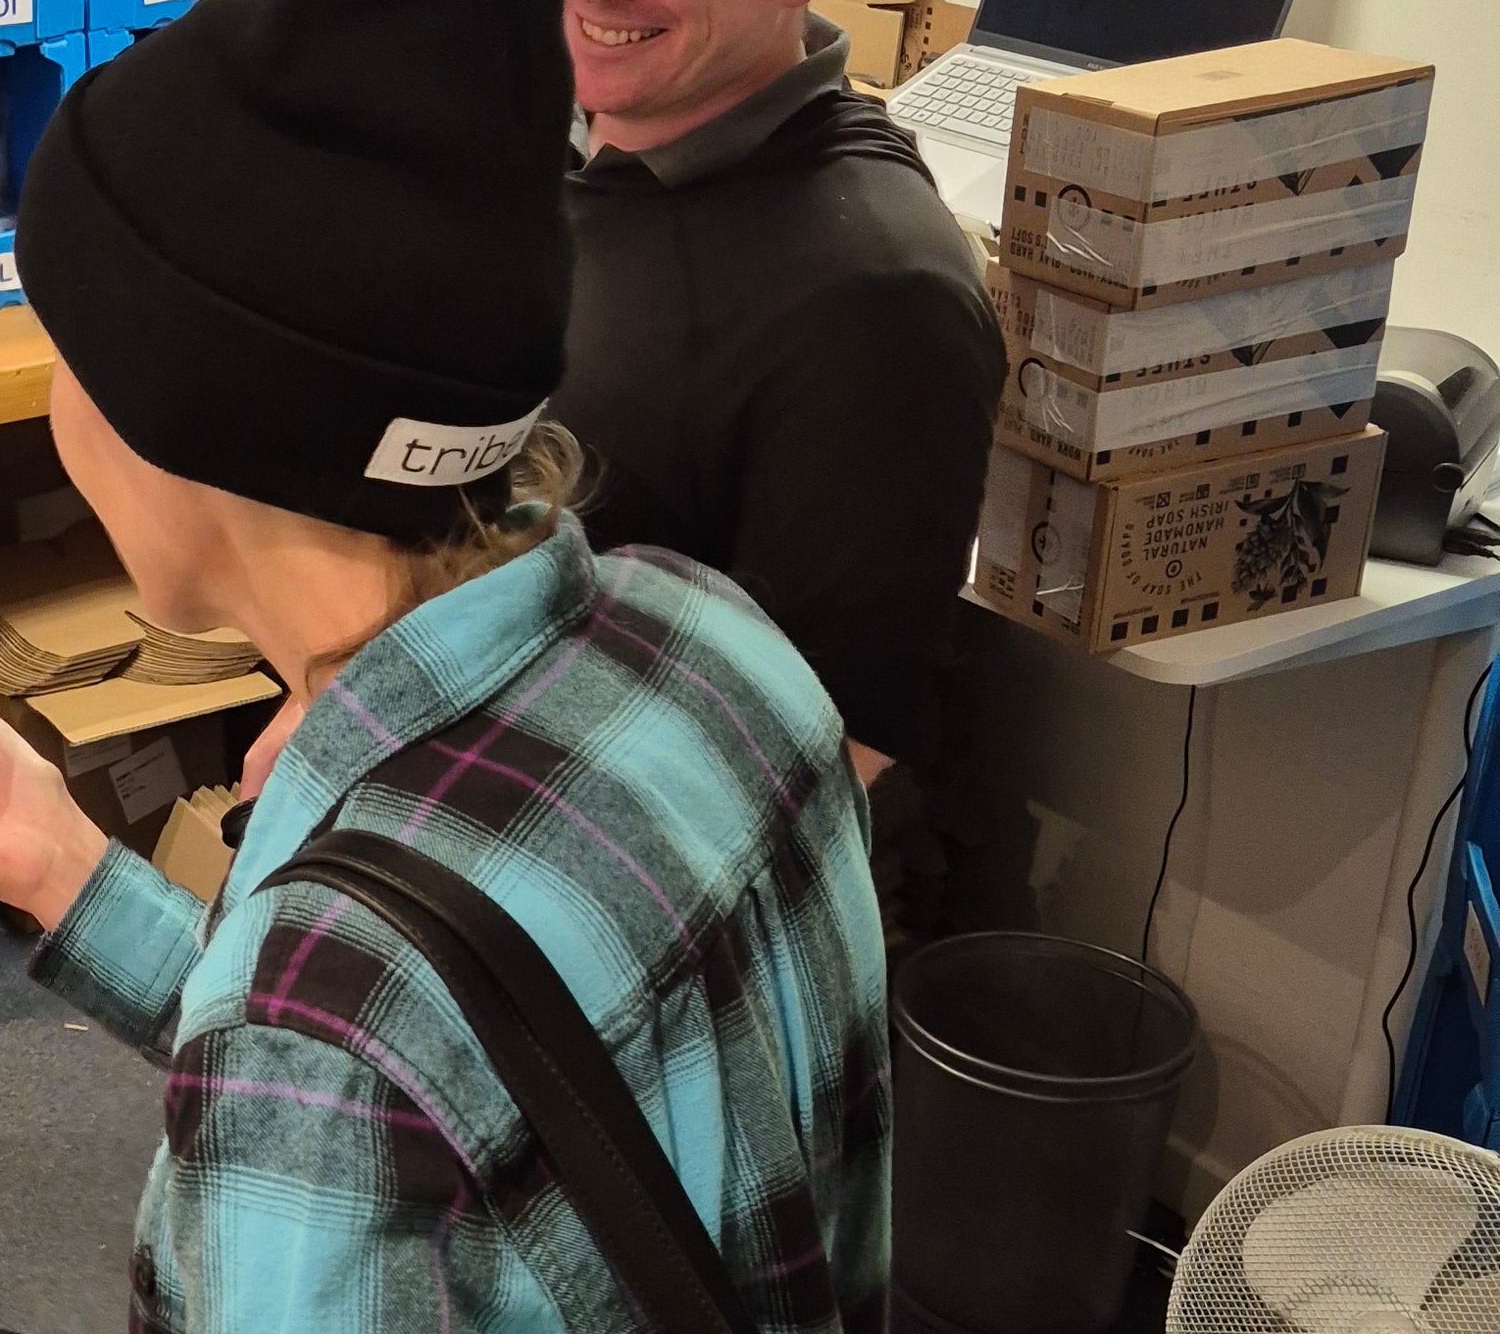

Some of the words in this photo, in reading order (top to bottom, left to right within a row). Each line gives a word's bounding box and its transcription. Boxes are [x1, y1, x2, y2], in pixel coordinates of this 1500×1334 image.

[1146, 508, 1185, 529] SOAP
[1190, 500, 1230, 519] IRISH
[1144, 517, 1225, 545] HANDMADE
[1143, 536, 1208, 562] NATURAL
